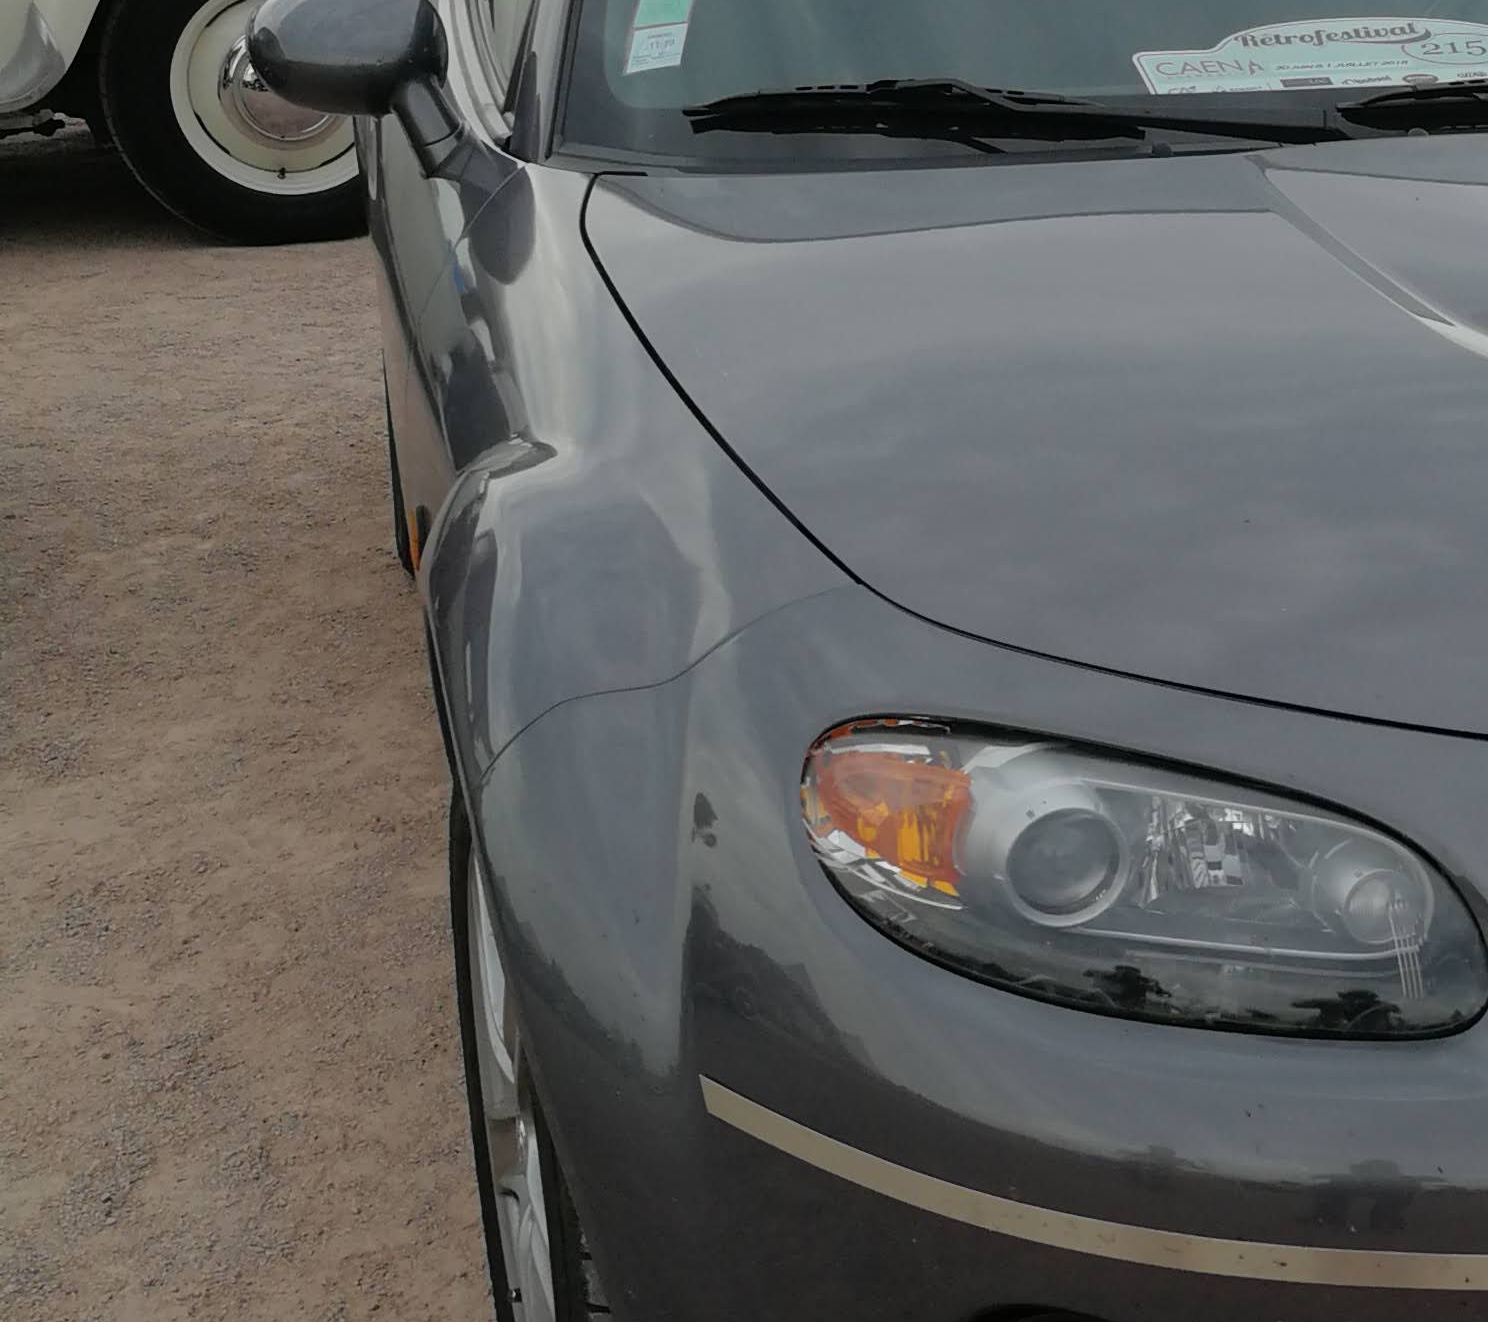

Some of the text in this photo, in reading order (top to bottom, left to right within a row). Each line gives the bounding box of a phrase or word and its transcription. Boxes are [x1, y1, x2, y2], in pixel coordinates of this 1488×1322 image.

[1234, 22, 1424, 49] Retrofestival
[1421, 41, 1488, 57] 215
[1155, 59, 1243, 77] CAEN
